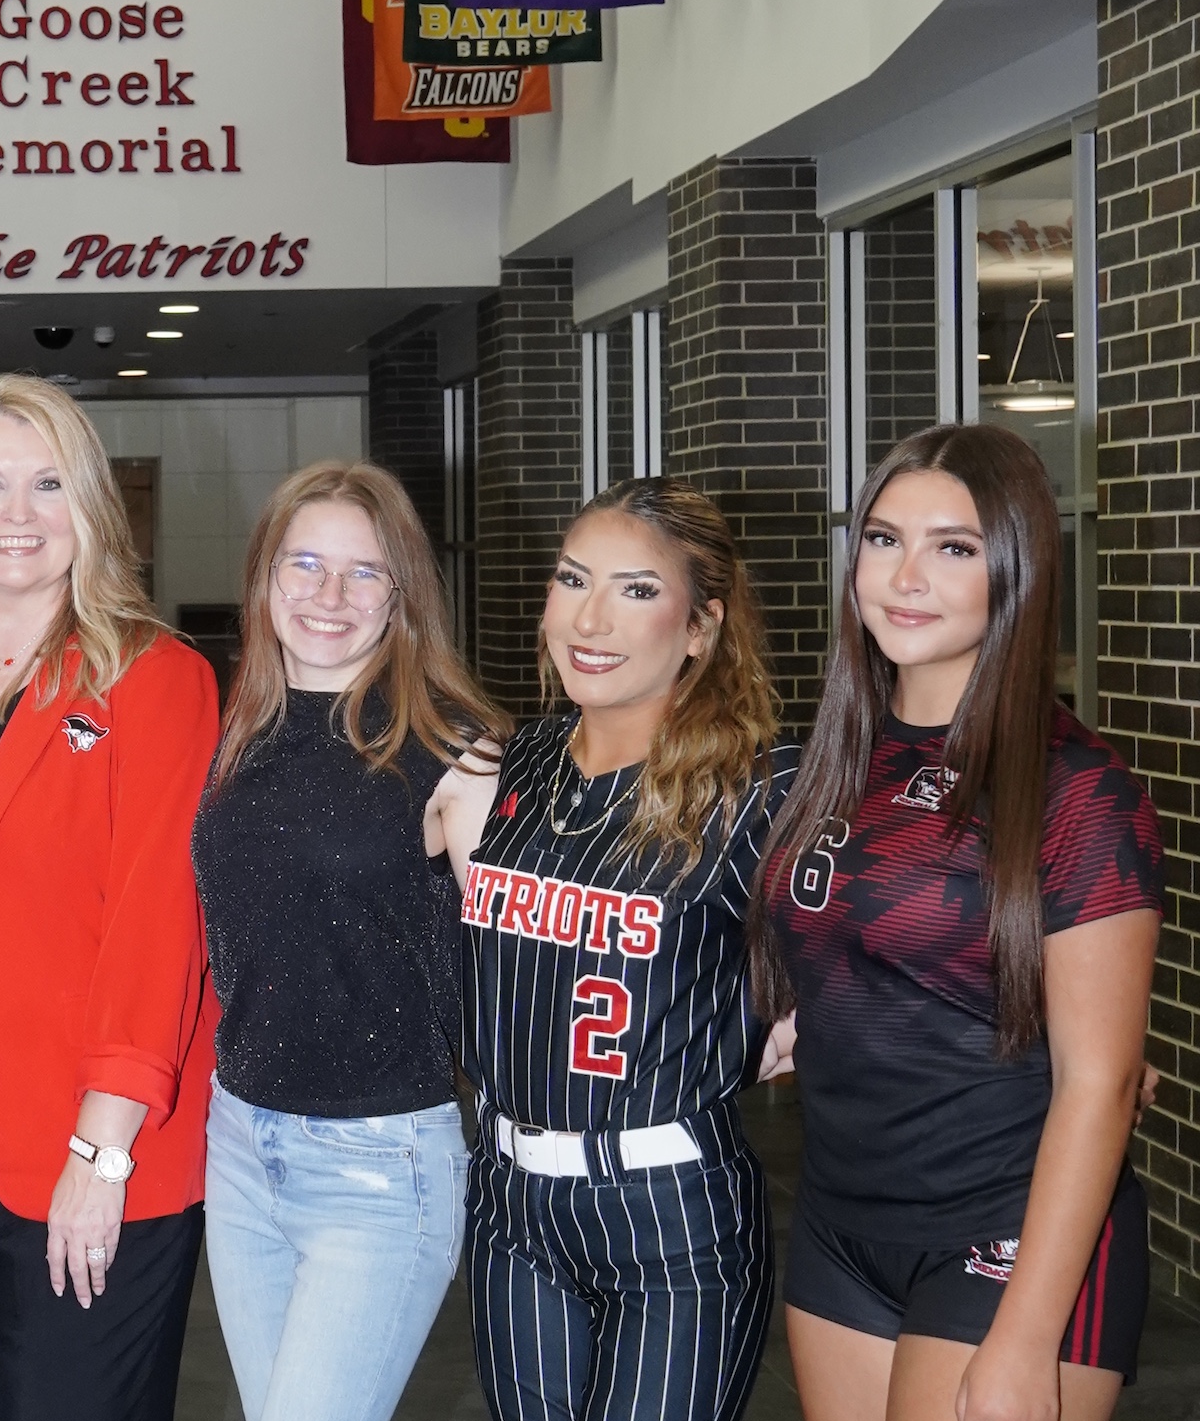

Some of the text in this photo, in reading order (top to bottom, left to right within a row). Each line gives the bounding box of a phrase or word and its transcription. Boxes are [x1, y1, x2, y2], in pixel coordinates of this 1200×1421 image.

[418, 3, 588, 40] BAYLOR
[456, 38, 550, 58] BEARS
[411, 68, 522, 107] FALCONS
[56, 231, 309, 279] Patriots
[789, 816, 850, 912] 6
[461, 861, 664, 960] ATRIOTS
[570, 974, 632, 1080] 2
